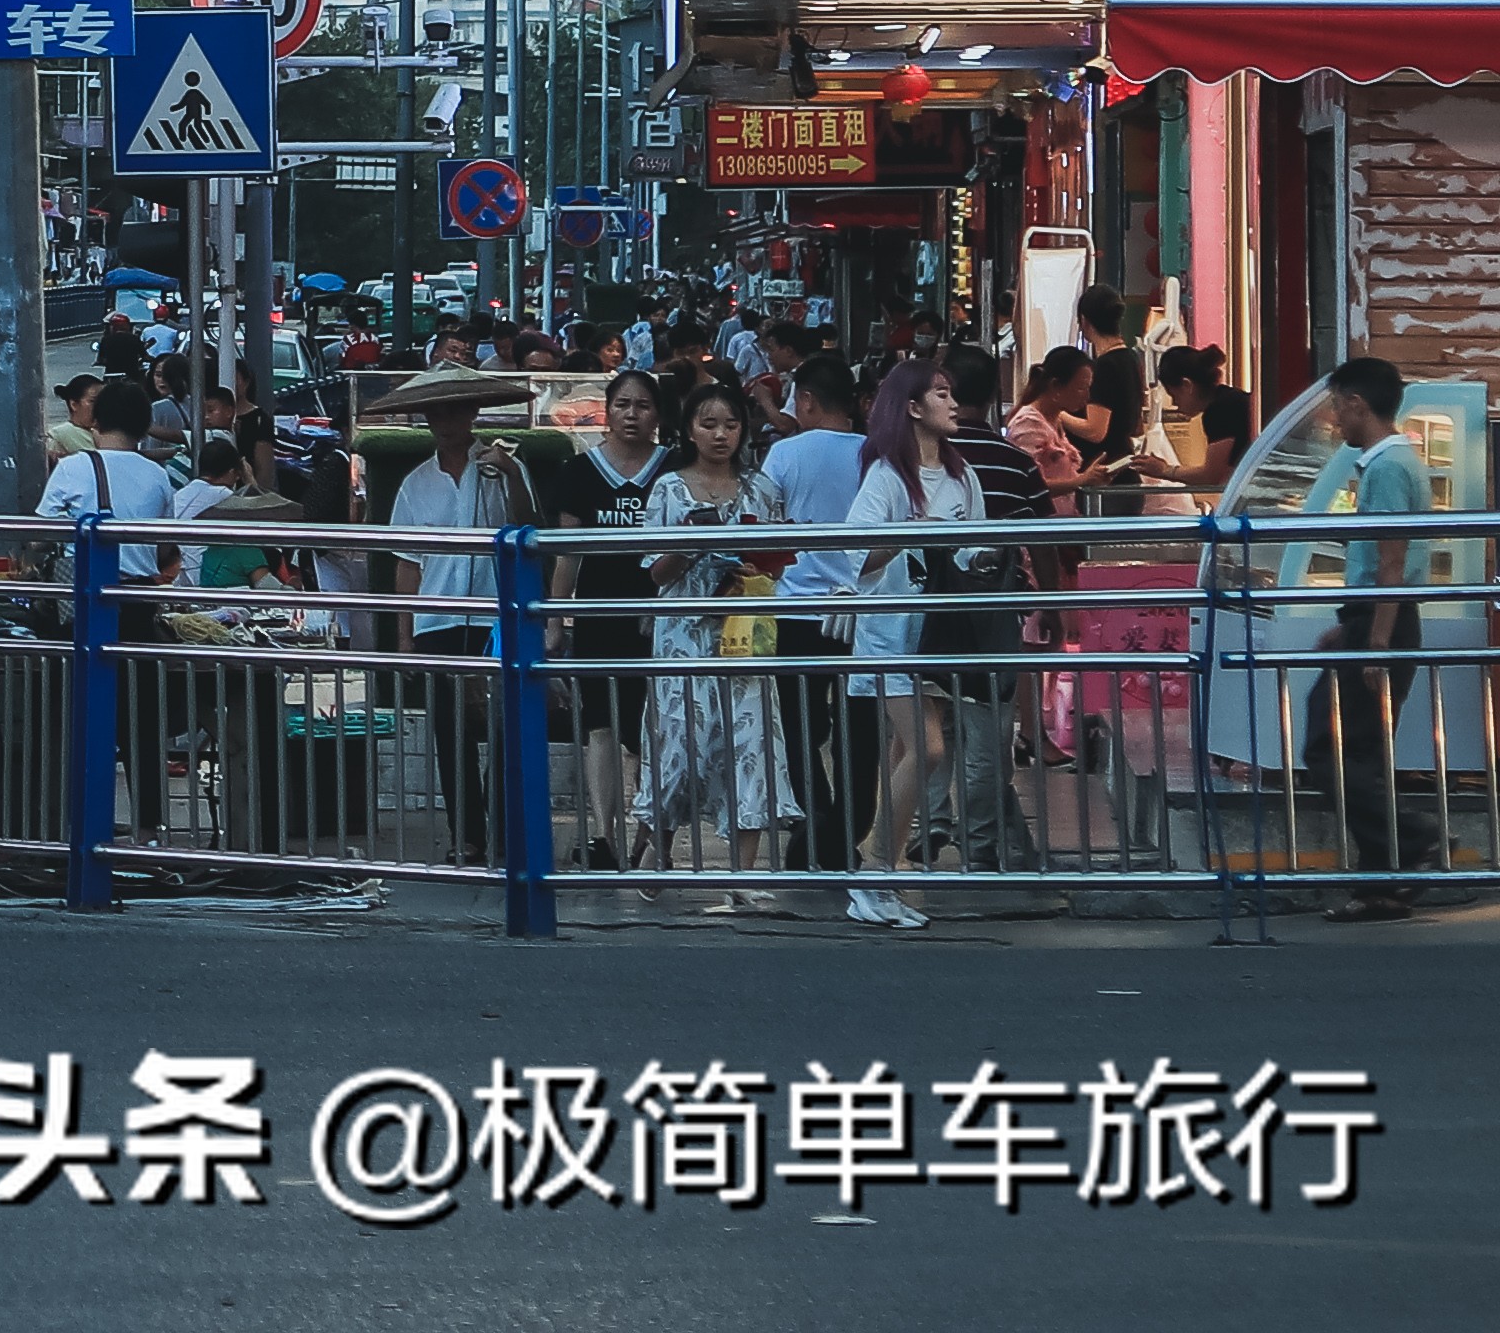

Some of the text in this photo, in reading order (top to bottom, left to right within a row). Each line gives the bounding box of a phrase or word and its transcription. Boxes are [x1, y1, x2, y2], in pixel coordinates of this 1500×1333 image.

[716, 109, 867, 149] 二楼门面直租
[716, 154, 827, 177] 13086950095
